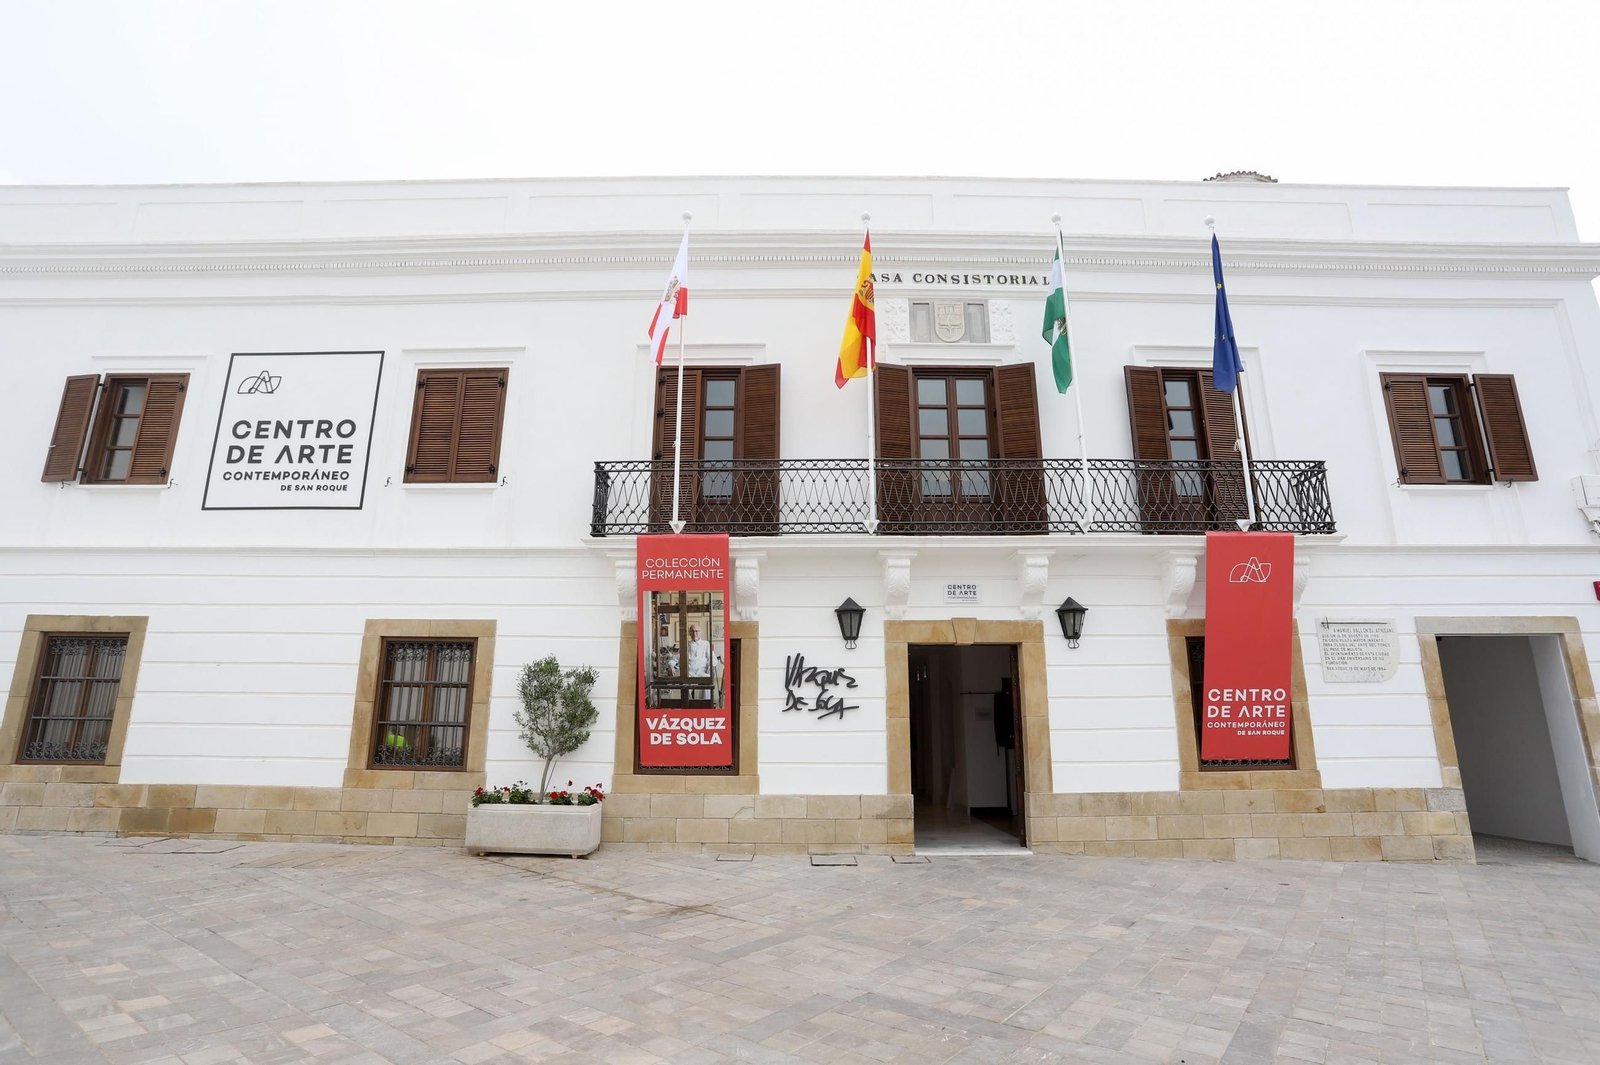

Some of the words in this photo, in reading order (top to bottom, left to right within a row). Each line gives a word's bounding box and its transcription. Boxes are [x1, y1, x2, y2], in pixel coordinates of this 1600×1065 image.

[862, 273, 902, 282] ASA
[912, 273, 1050, 286] CONSISTORIAL
[231, 419, 357, 440] CENTRO
[226, 445, 265, 464] DE
[274, 444, 354, 464] ARTE
[222, 469, 350, 481] CONTEMPORÁNEO
[316, 484, 348, 492] ROQUE
[645, 555, 721, 569] COLECCIÓN
[641, 568, 725, 580] PERMANENTE
[1208, 688, 1286, 701] CENTRO
[1207, 705, 1231, 718] DE
[1238, 705, 1286, 718] ARTE
[646, 714, 726, 733] VÁZQUEZ
[1207, 720, 1285, 728] CONTEMPORÁNEO
[649, 733, 672, 746] DE
[676, 732, 722, 746] SOLA
